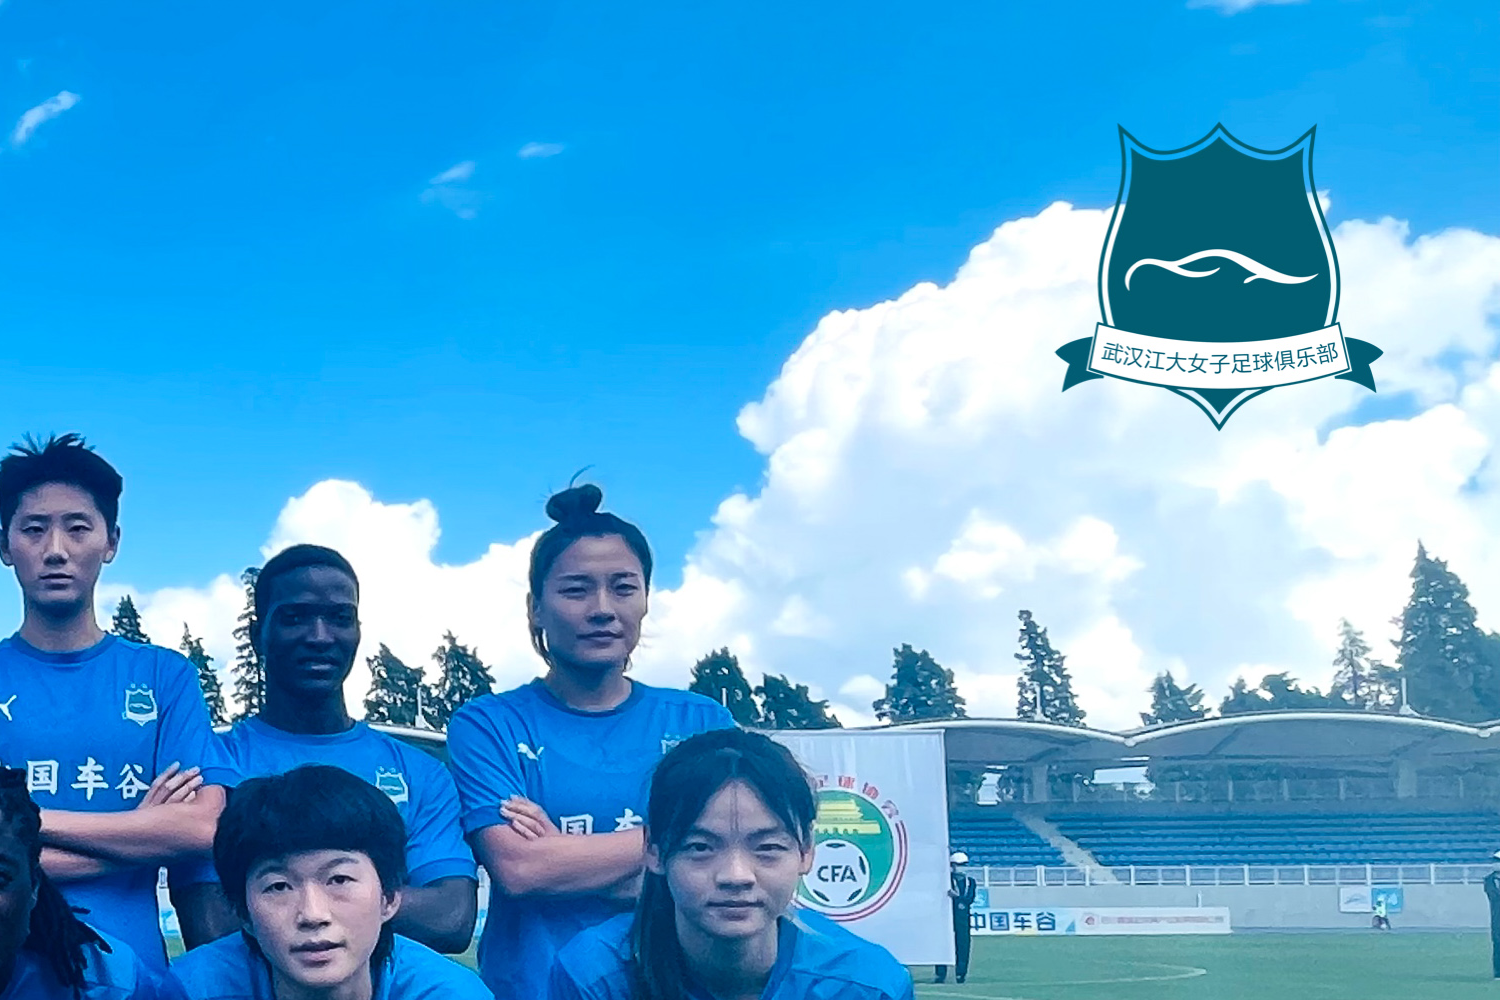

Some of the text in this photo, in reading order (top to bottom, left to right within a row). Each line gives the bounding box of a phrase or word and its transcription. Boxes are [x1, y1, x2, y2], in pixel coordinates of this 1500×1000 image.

[816, 864, 859, 883] CFA
[969, 911, 1057, 932] 中国车谷
